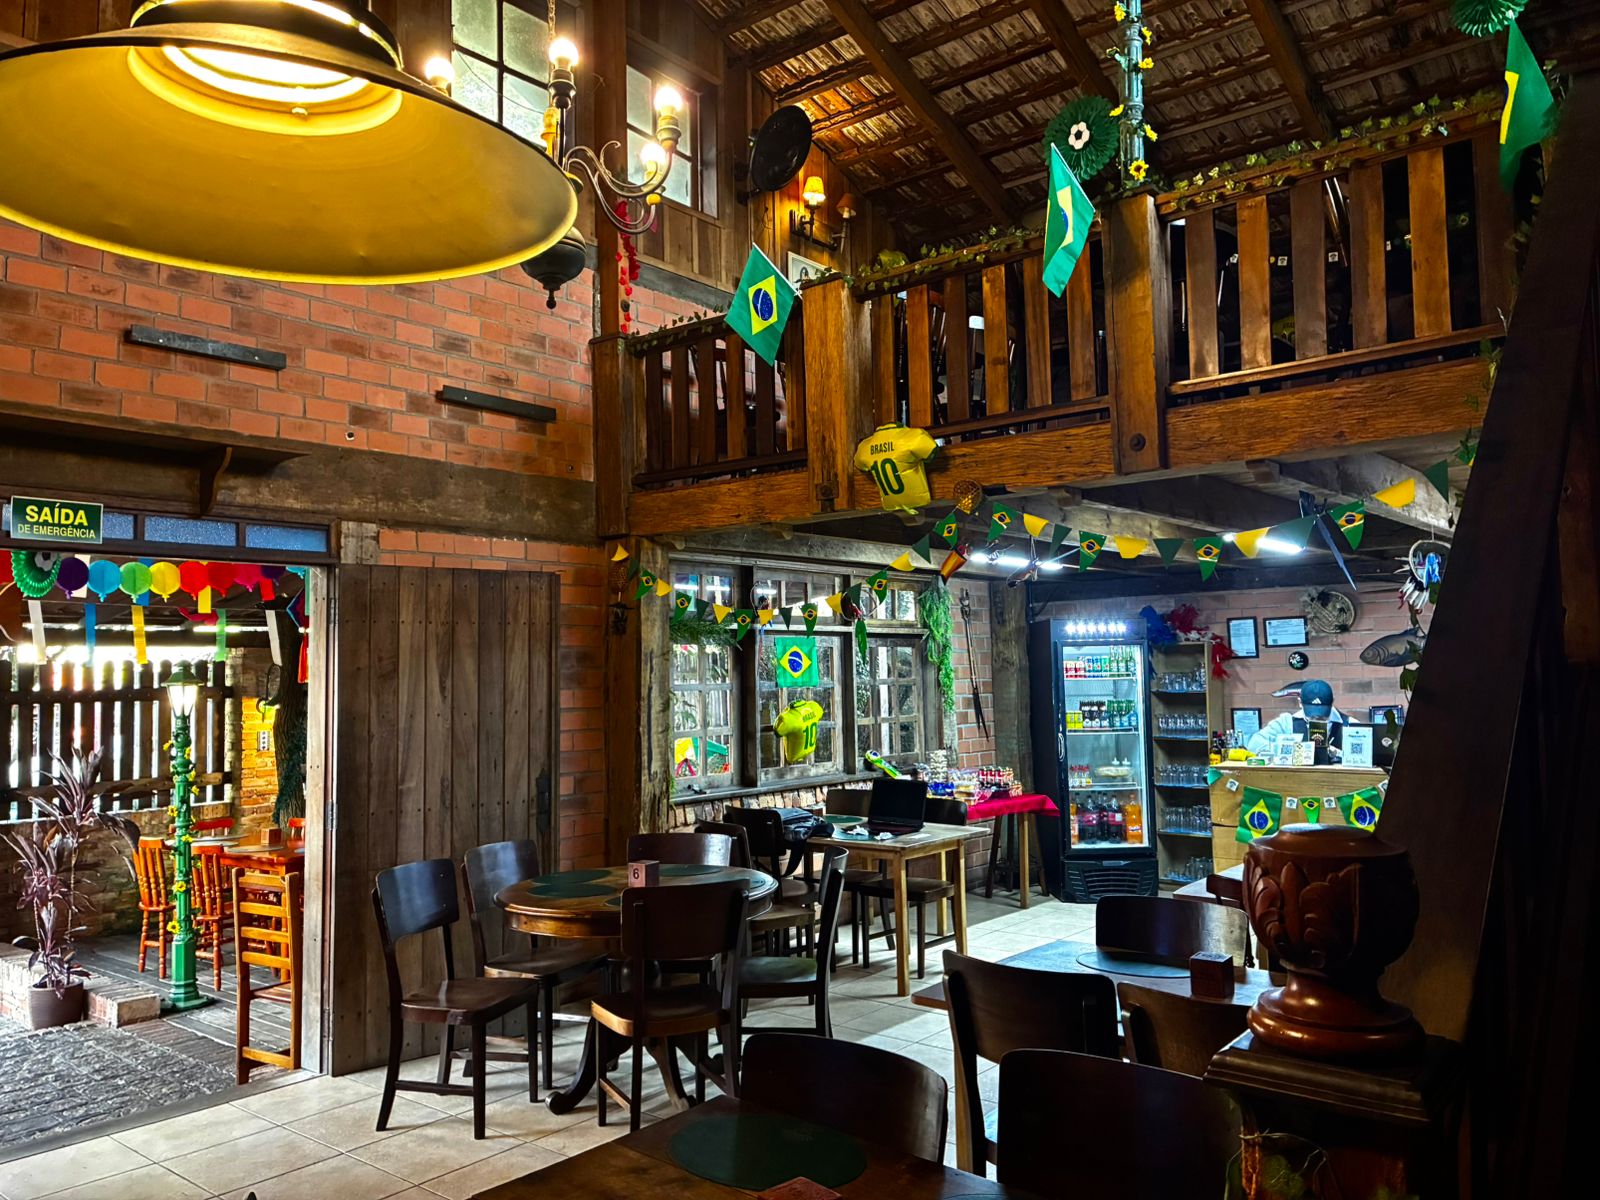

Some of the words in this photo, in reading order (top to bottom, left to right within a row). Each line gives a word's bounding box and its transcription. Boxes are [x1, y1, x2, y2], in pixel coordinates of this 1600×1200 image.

[870, 442, 895, 455] BRASIL
[871, 458, 905, 496] 10
[25, 503, 88, 526] SAÍDA
[18, 524, 31, 534] DE
[33, 526, 96, 538] EMERGÊNCIA
[803, 722, 817, 749] 10
[633, 868, 640, 879] 6
